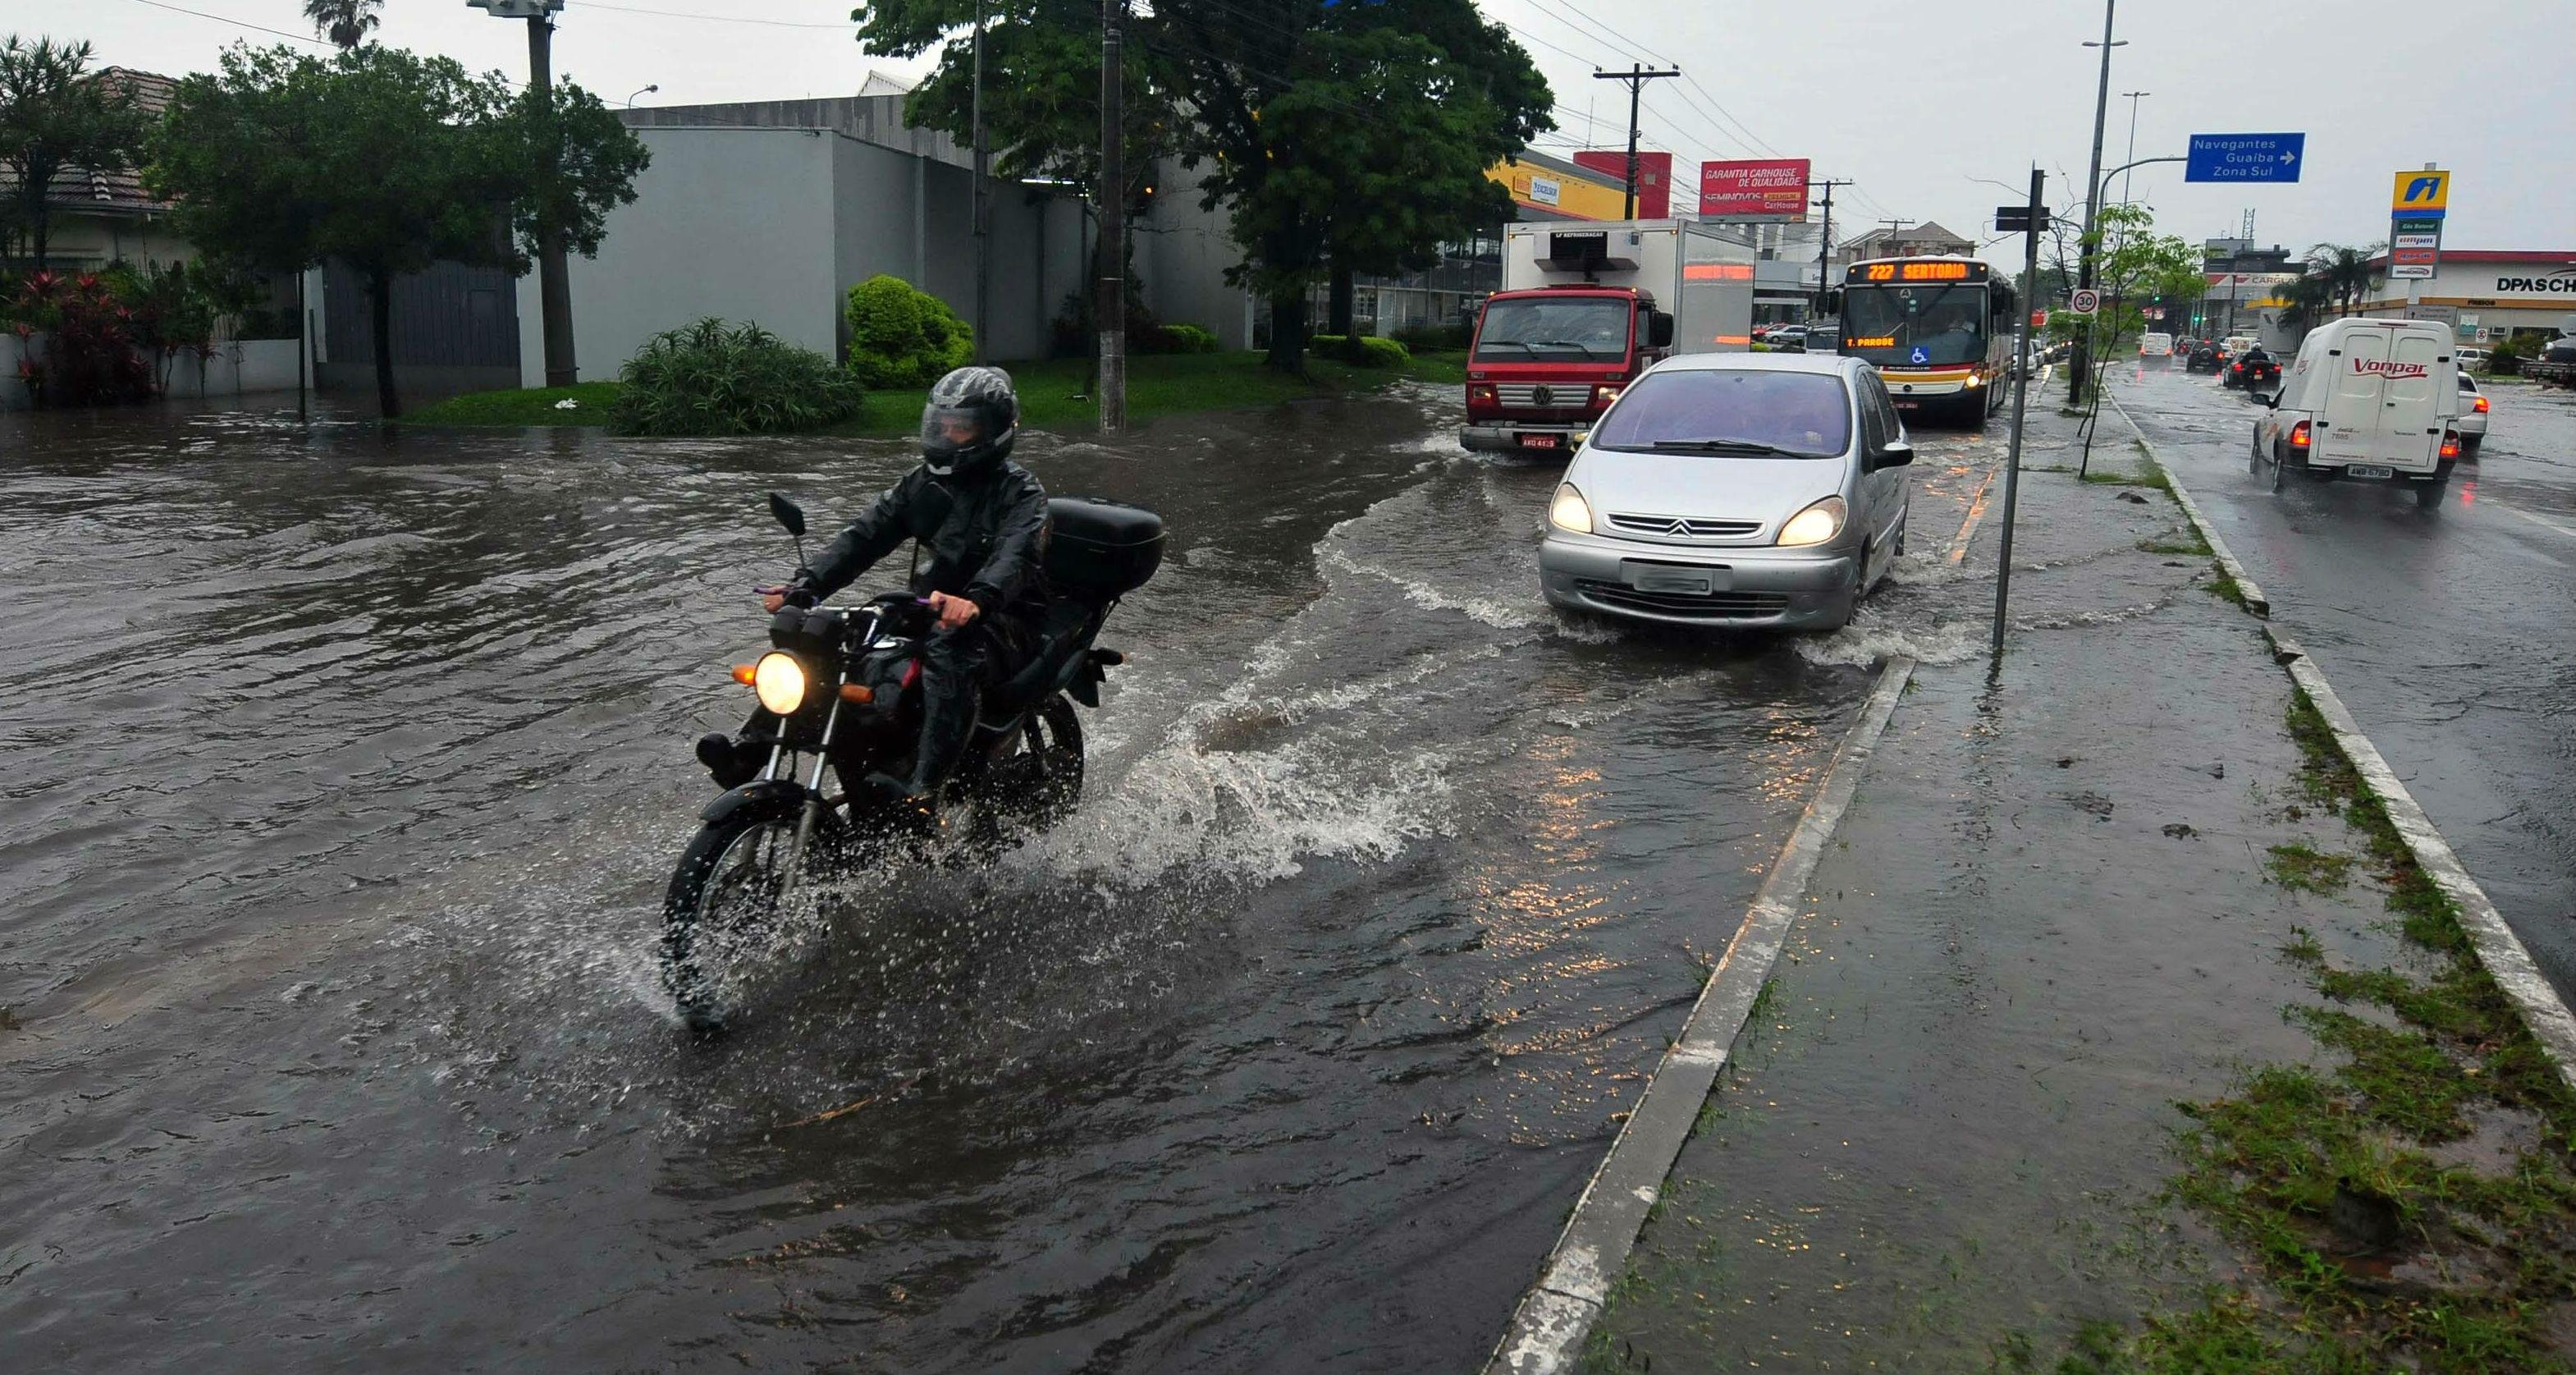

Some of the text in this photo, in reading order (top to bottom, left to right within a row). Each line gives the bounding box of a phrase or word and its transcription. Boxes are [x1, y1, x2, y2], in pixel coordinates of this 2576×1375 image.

[2194, 140, 2276, 149] Navegantes
[1705, 167, 1796, 180] GARANTIA CARHOUSE
[2213, 166, 2272, 176] Zona Sul
[1738, 178, 1750, 187] DE
[1705, 193, 1761, 203] SEMINOVOS
[1764, 201, 1799, 209] CarHouse
[1869, 264, 1967, 280] 727 SERTORIO
[2079, 296, 2093, 305] 30
[1847, 338, 1856, 346] T.
[2354, 358, 2427, 374] Vonpar
